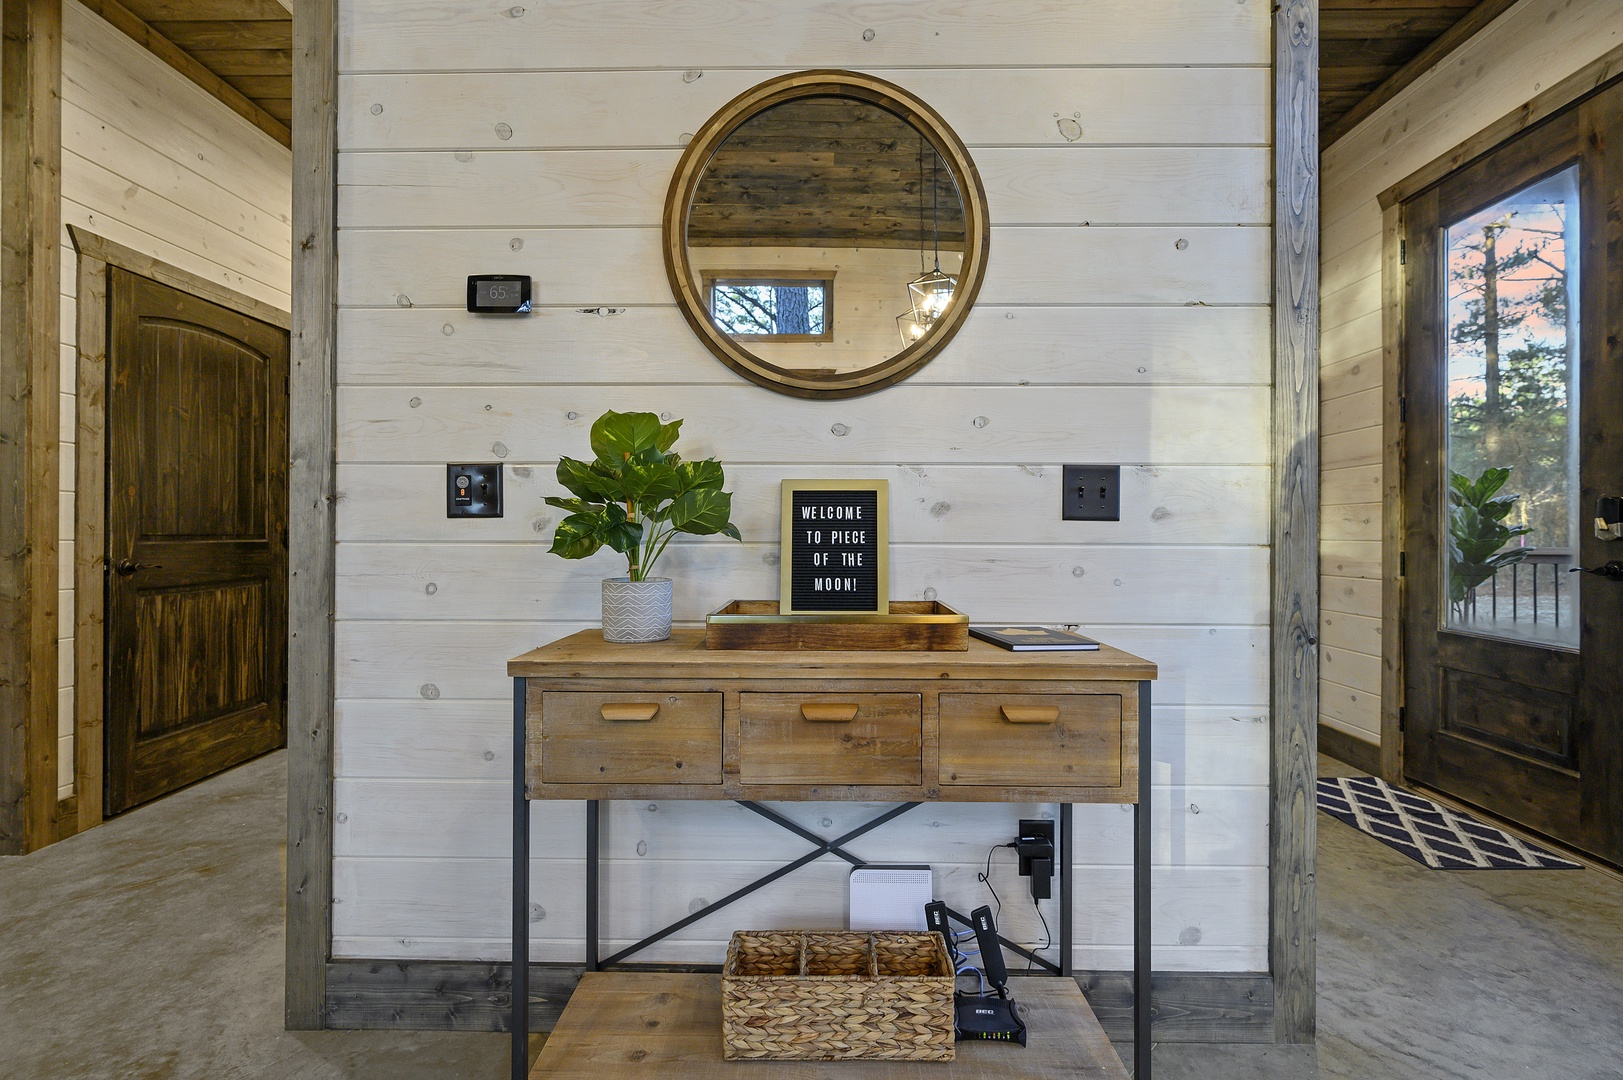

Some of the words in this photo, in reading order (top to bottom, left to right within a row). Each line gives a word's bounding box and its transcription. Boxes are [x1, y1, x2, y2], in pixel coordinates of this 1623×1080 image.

[802, 506, 862, 520] WELCOME
[806, 530, 821, 544] TO
[831, 530, 866, 545] PIECE
[813, 552, 829, 567] OF
[841, 552, 863, 567] THE
[814, 577, 857, 591] MOON!
